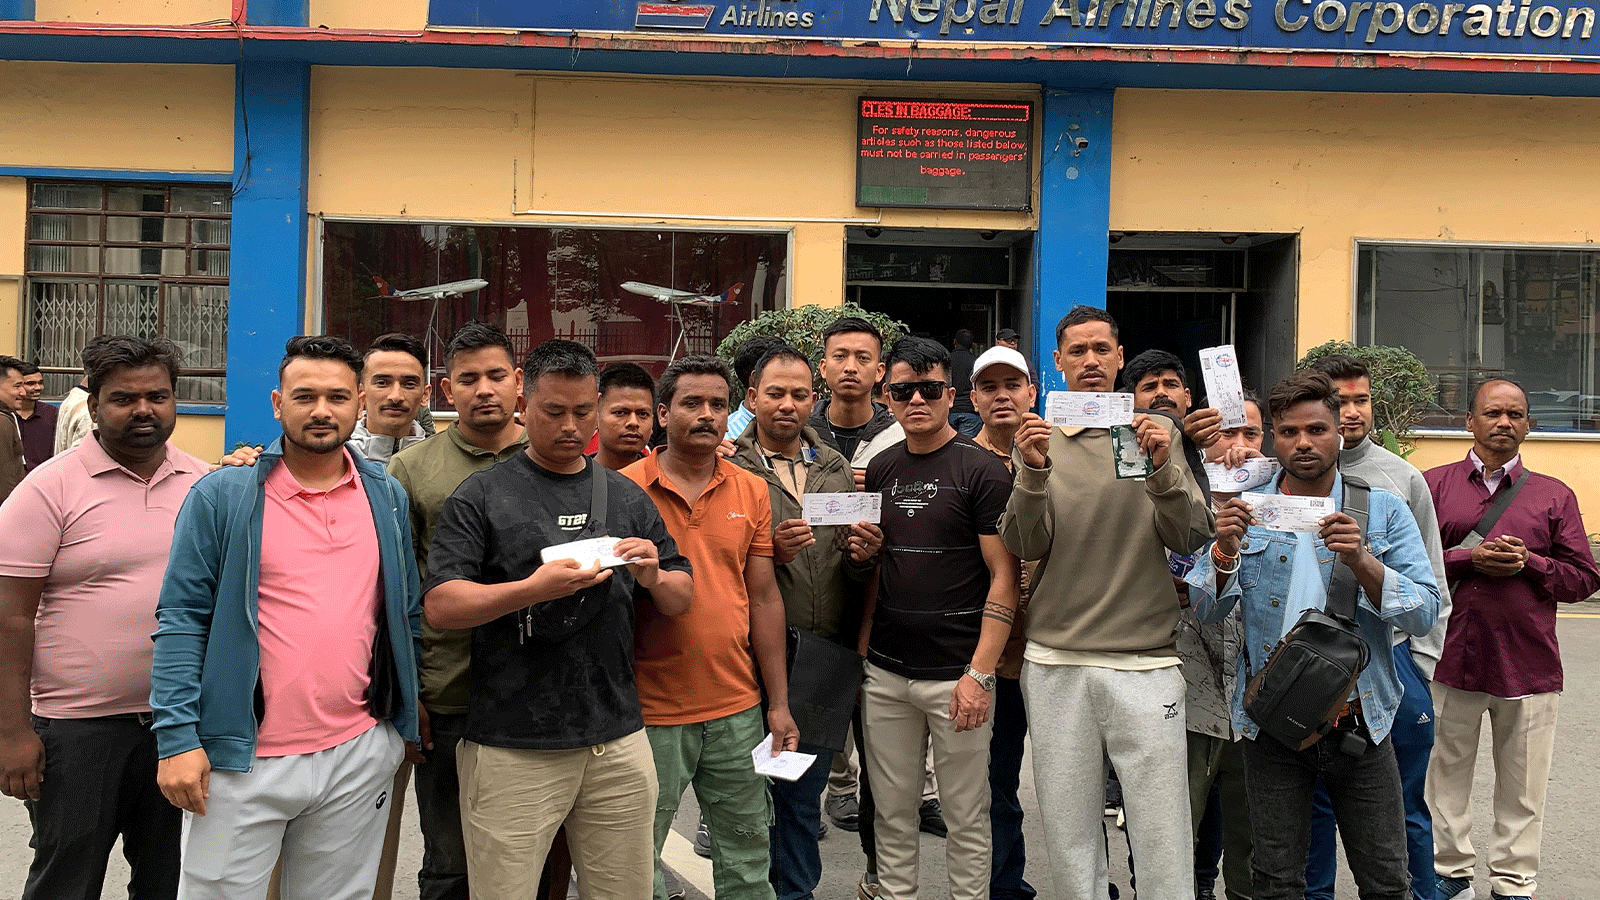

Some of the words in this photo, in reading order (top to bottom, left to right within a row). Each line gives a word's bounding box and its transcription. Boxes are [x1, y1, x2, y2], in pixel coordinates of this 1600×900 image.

[720, 4, 816, 28] Airlines
[868, 0, 1025, 35] Nepal
[1040, 0, 1252, 30] Airlines
[1274, 0, 1596, 43] Corporation
[896, 104, 908, 117] IN
[911, 104, 971, 119] BAGGAGE:
[872, 124, 889, 135] For
[891, 126, 920, 138] safety
[965, 127, 1017, 139] dangerous
[861, 136, 896, 146] articles
[898, 138, 922, 147] such
[937, 138, 964, 148] those
[966, 139, 994, 149] listed
[860, 148, 884, 158] must
[886, 149, 903, 158] not
[905, 149, 918, 159] be
[920, 150, 954, 160] carried
[956, 150, 966, 160] in
[920, 165, 966, 177] baggage.
